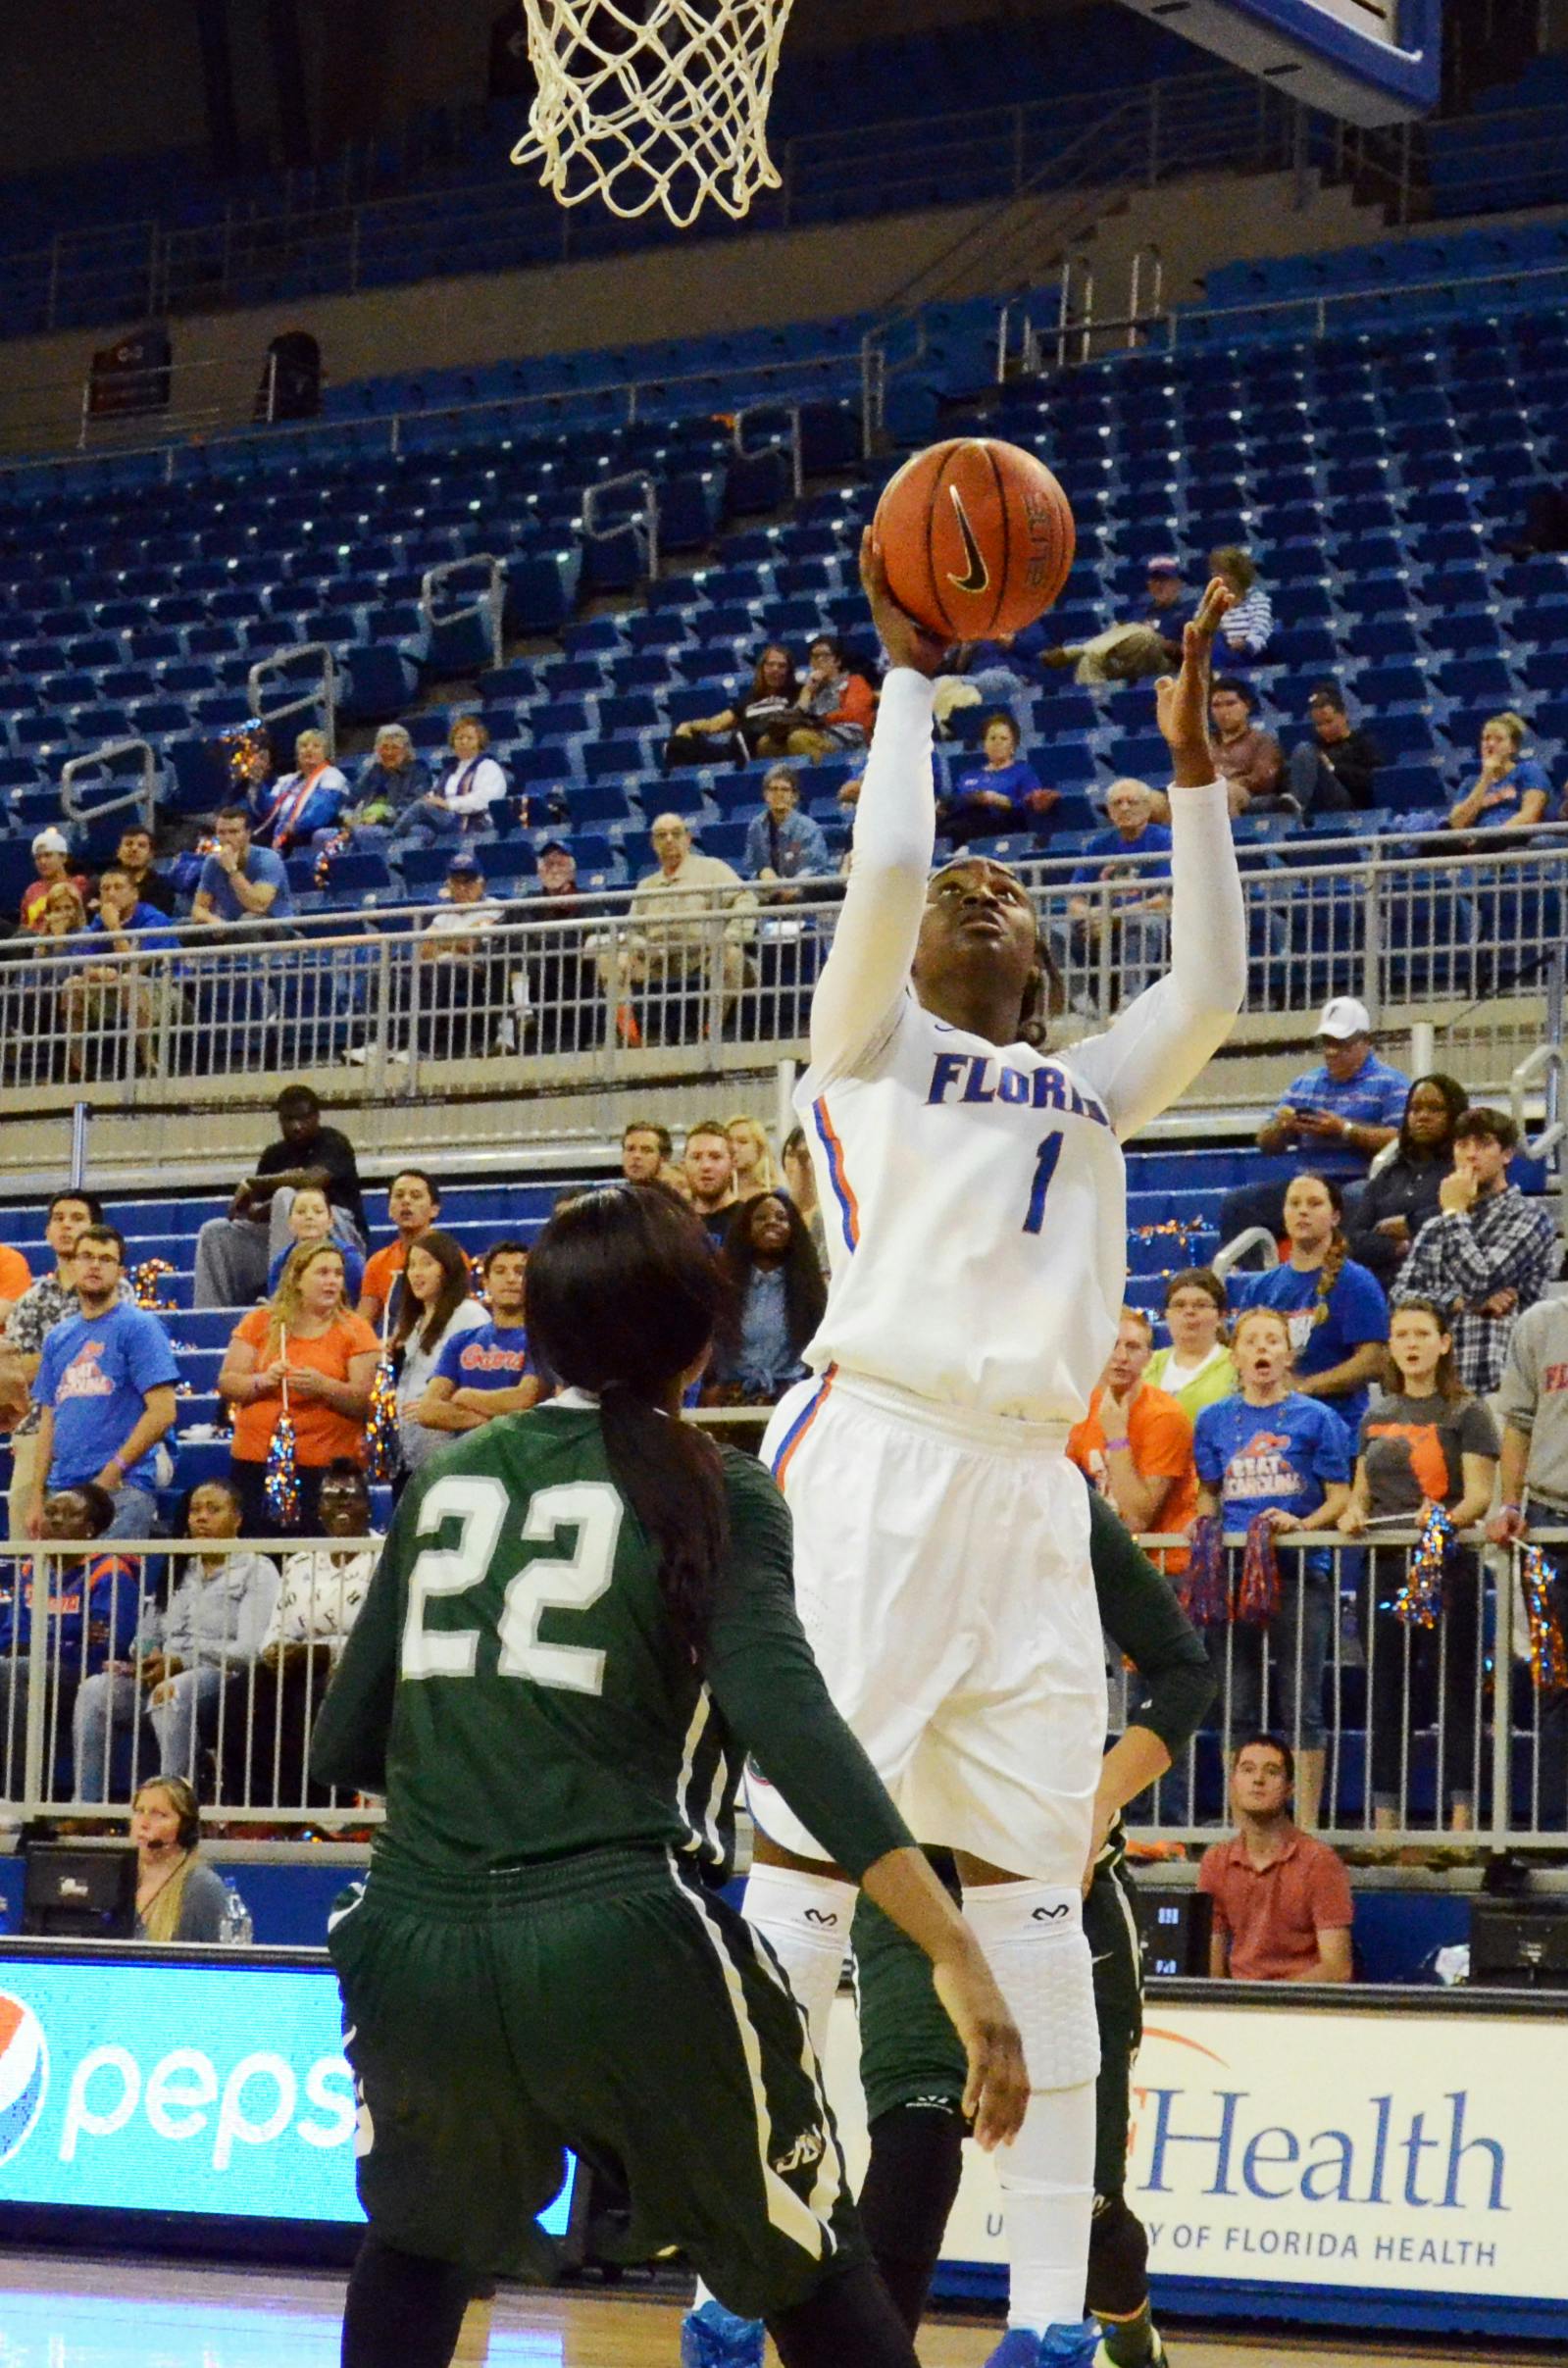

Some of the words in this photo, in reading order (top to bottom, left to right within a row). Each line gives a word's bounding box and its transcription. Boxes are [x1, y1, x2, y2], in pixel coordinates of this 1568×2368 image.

[1023, 1131, 1063, 1234] 1
[401, 1475, 625, 1696] 22
[59, 2044, 356, 2171] peps
[1173, 2222, 1212, 2248] OF
[1224, 2226, 1358, 2259] FLORIDA
[1374, 2235, 1496, 2267] HEALTH
